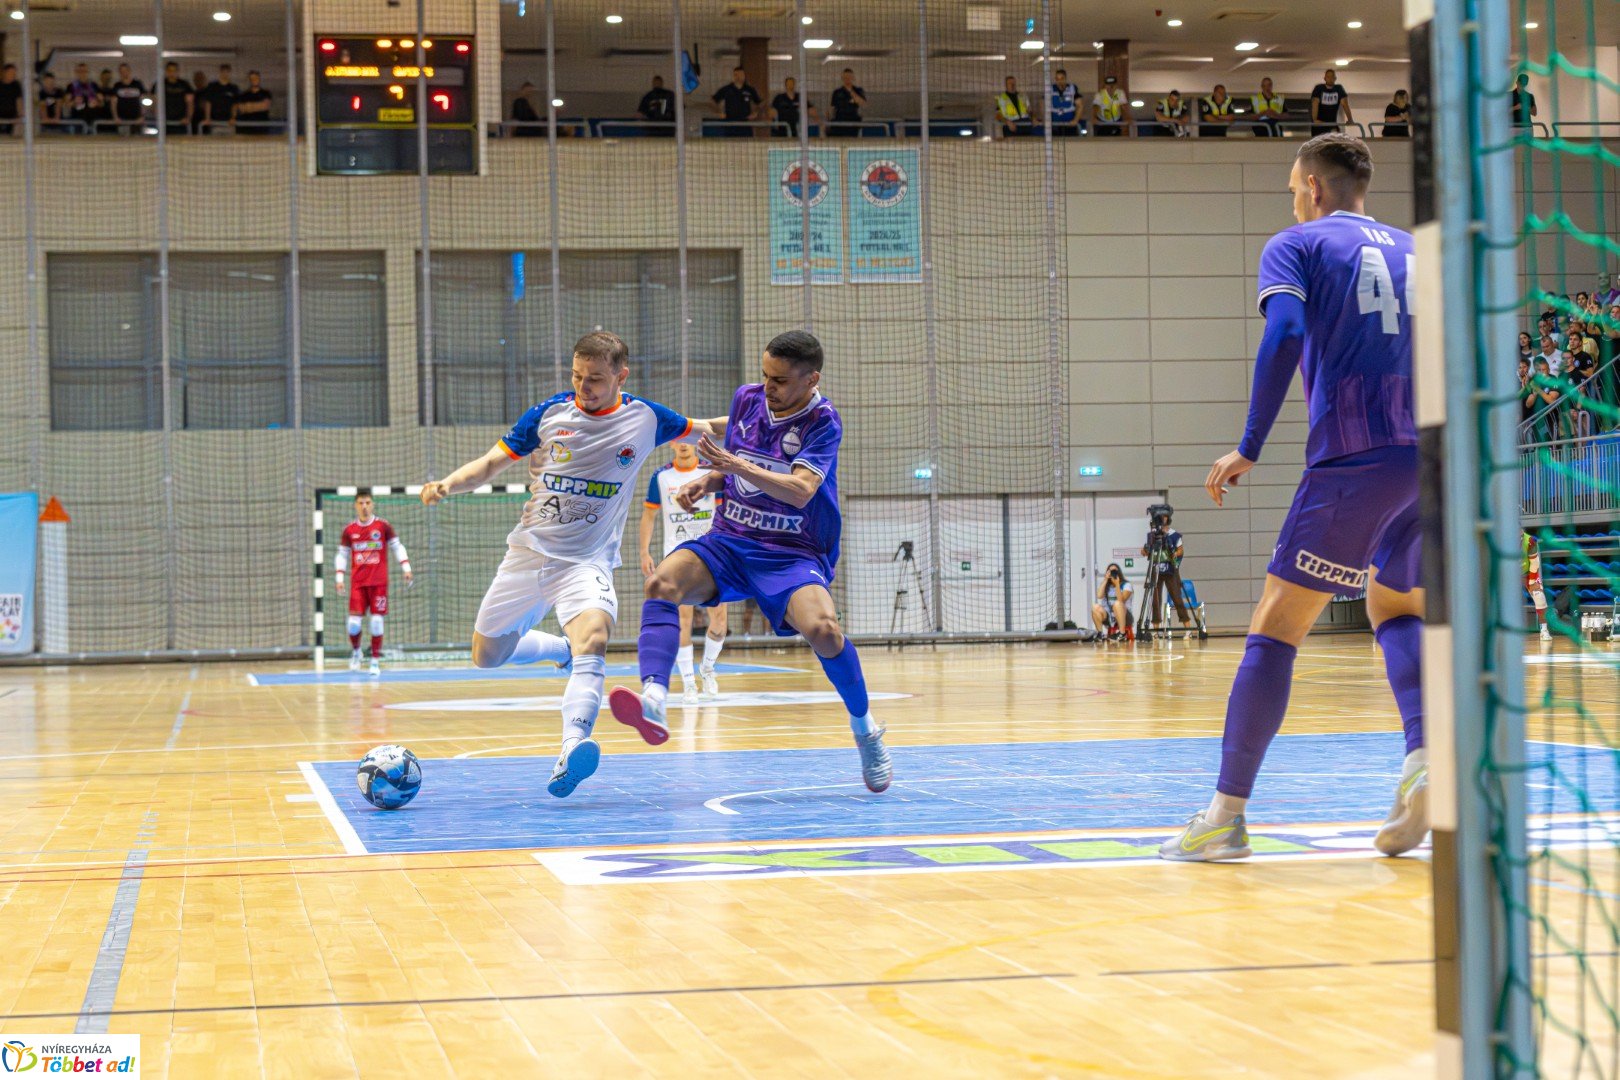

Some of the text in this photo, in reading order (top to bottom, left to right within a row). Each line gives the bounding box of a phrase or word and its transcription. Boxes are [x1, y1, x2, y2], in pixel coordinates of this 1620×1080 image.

[1360, 226, 1396, 246] VAS
[1356, 245, 1418, 335] 4
[727, 502, 802, 532] TiPPMIX
[595, 576, 610, 591] 9
[1298, 552, 1366, 587] TiPPMI
